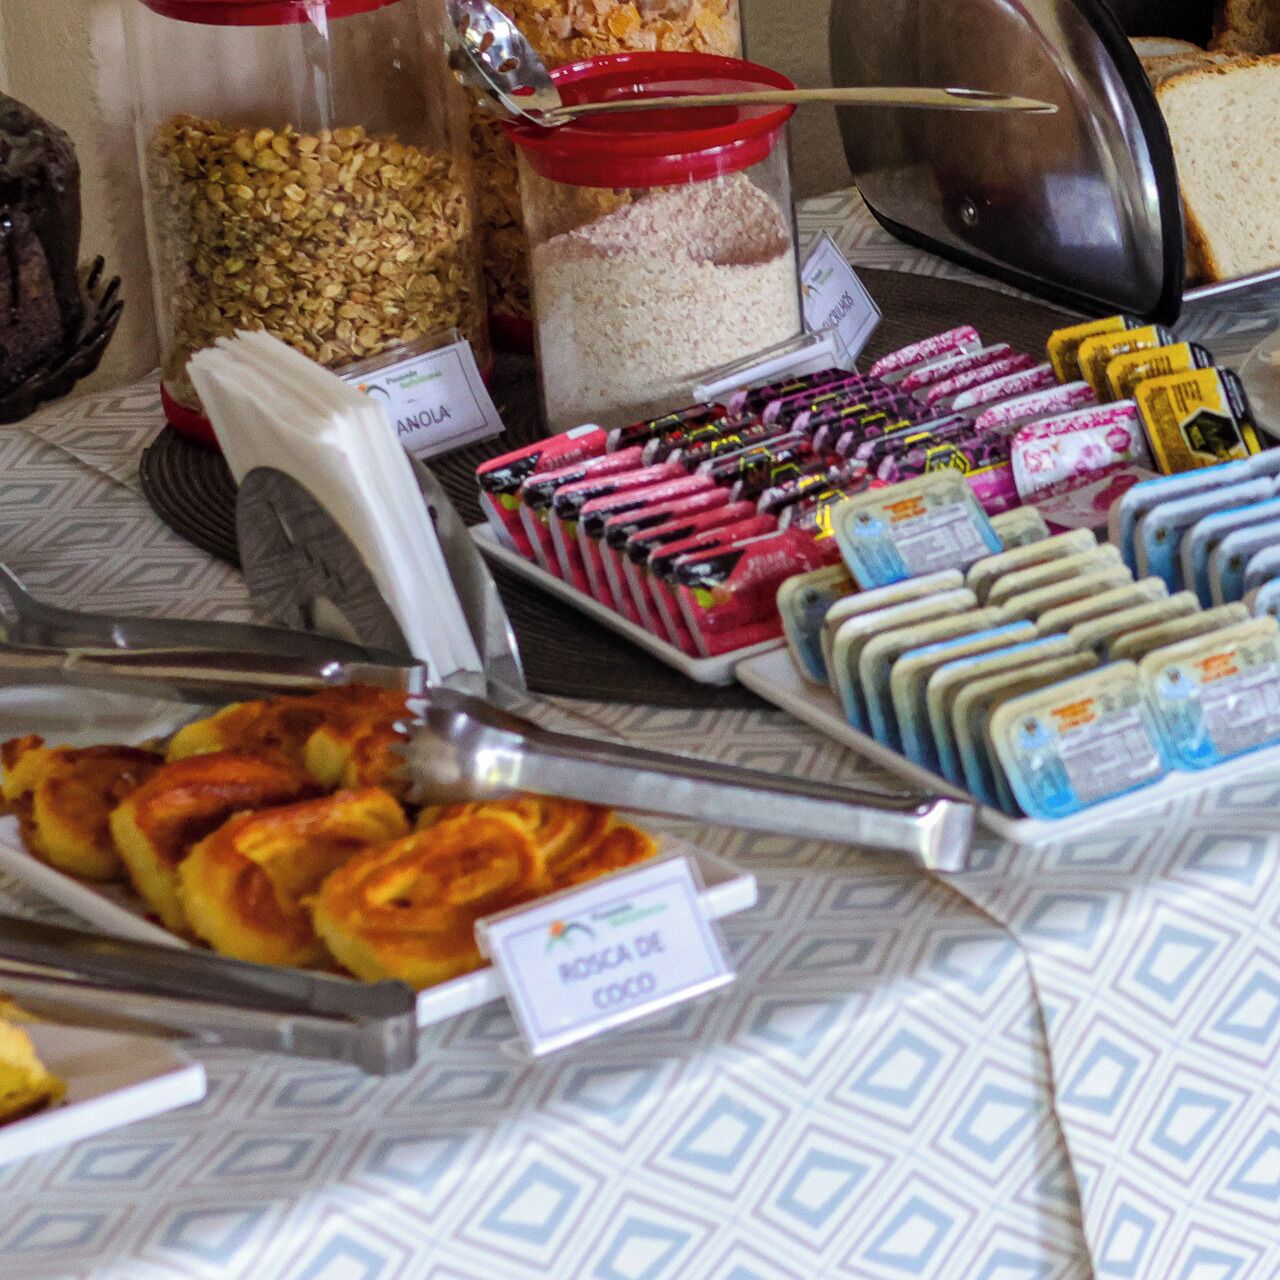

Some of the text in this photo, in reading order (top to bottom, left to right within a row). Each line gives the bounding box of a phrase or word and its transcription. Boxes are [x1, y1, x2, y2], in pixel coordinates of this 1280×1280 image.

[397, 405, 451, 437] ANOLA
[557, 930, 666, 985] ROSCA DE
[592, 972, 657, 1010] COCO
